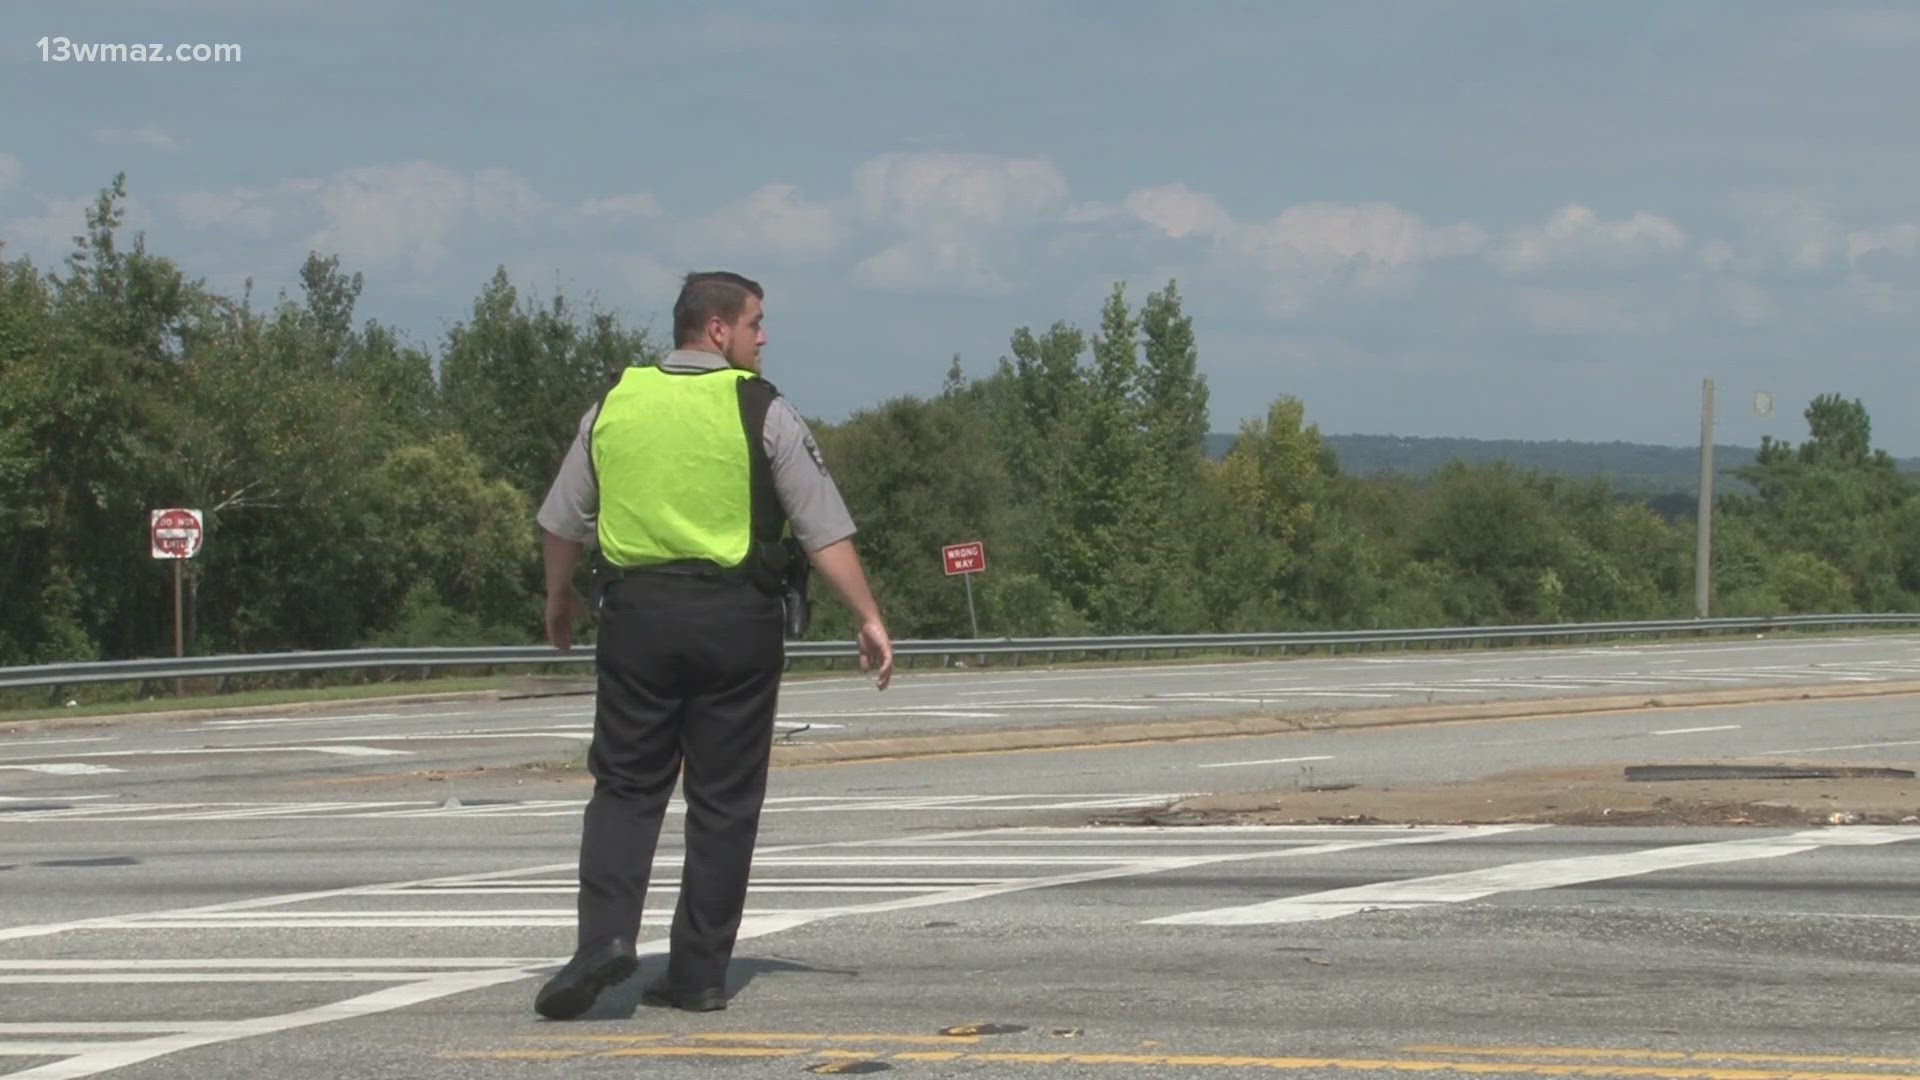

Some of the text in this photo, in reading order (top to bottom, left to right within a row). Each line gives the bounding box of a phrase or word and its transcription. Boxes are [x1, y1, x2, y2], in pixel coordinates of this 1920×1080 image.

[159, 518, 173, 527] DO
[947, 546, 979, 559] WRONG
[954, 558, 974, 569] WAY
